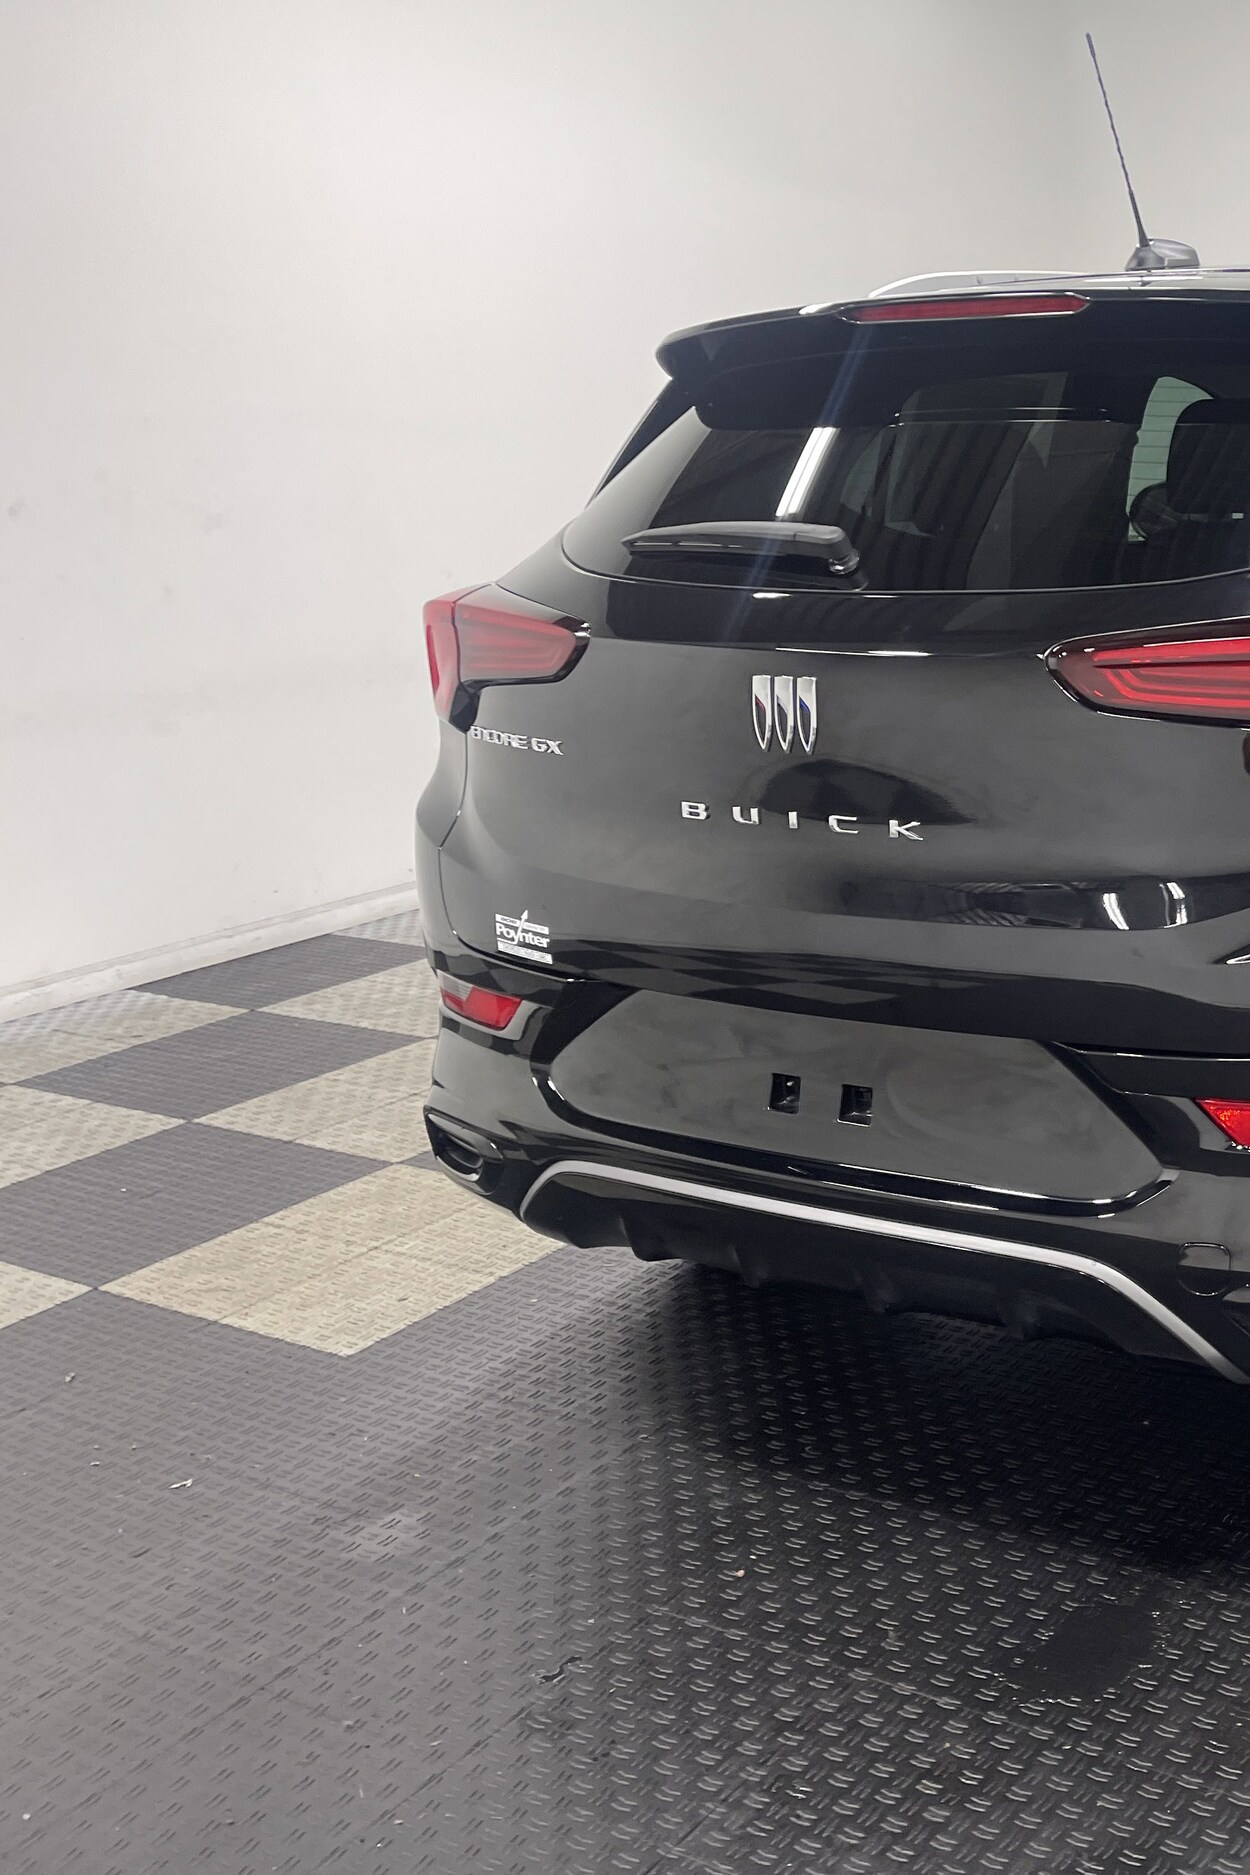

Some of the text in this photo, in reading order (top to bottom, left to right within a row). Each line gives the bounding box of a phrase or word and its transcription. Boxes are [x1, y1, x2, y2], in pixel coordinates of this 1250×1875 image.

[531, 737, 564, 756] GX
[681, 801, 924, 841] BUICK
[495, 922, 551, 949] Poynter
